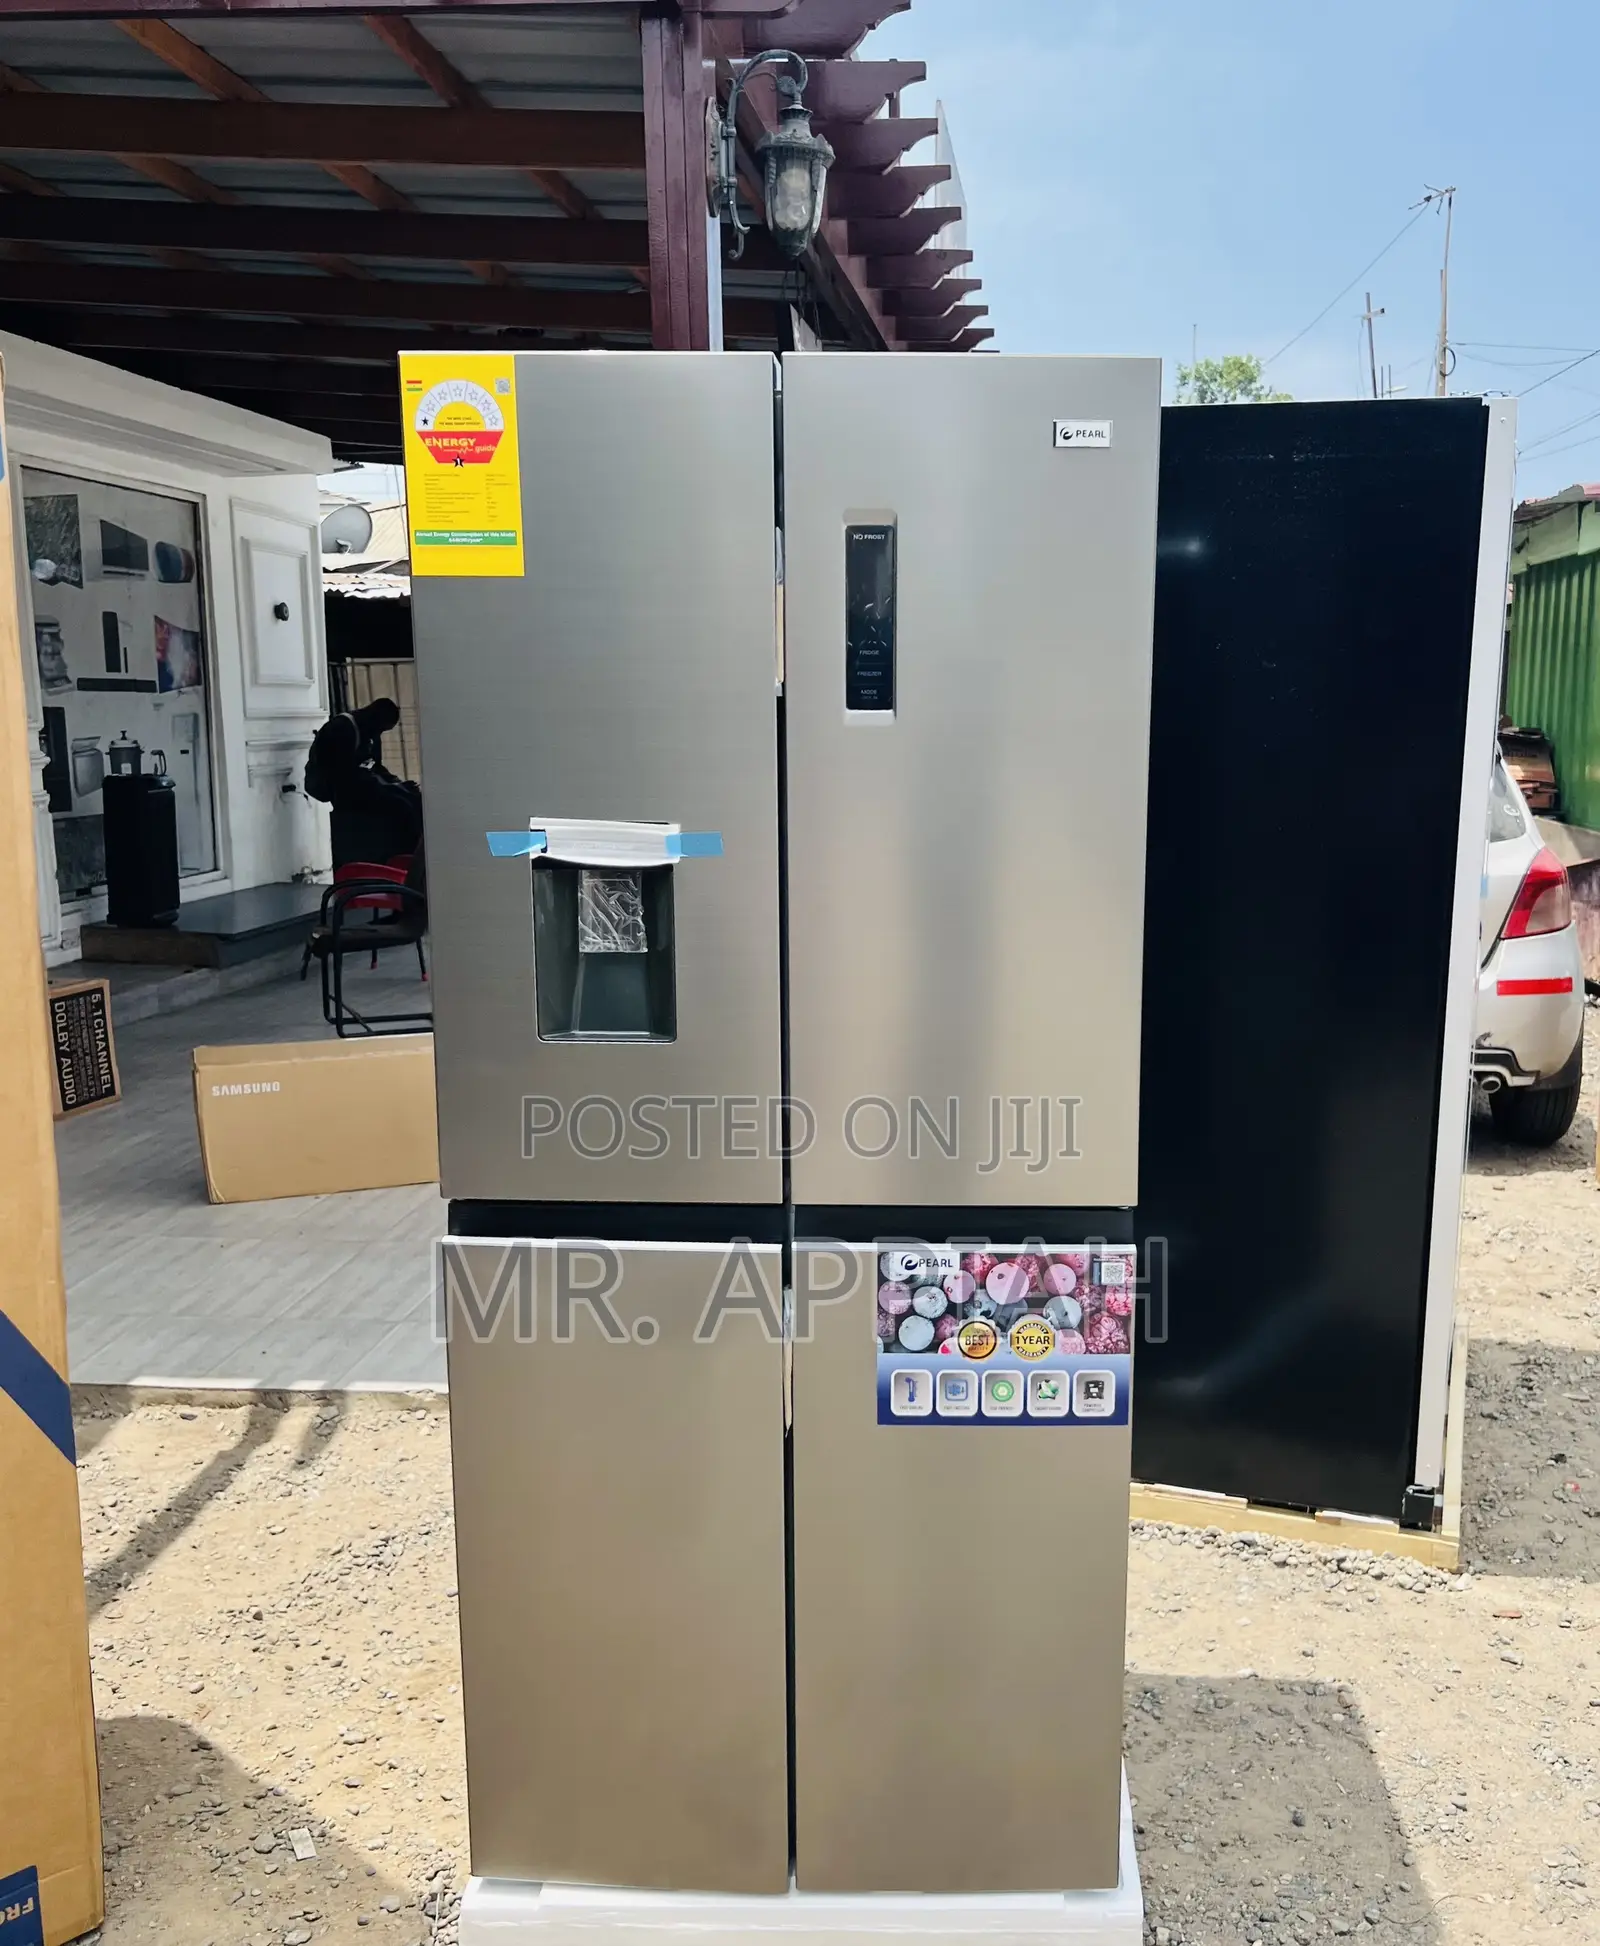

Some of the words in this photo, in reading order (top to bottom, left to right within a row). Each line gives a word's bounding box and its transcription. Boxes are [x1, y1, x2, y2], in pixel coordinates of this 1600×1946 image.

[1075, 429, 1106, 438] PEARL
[425, 437, 476, 449] ENERGY
[54, 1001, 70, 1052] DOLBY
[60, 1057, 77, 1105] AUDIO
[211, 1081, 281, 1097] SAMSUNG
[918, 1258, 954, 1268] PEARL
[1017, 1323, 1049, 1335] WARRANTY
[965, 1335, 990, 1346] BEST
[1022, 1336, 1050, 1345] YEAR
[1017, 1346, 1049, 1357] WARRANTY
